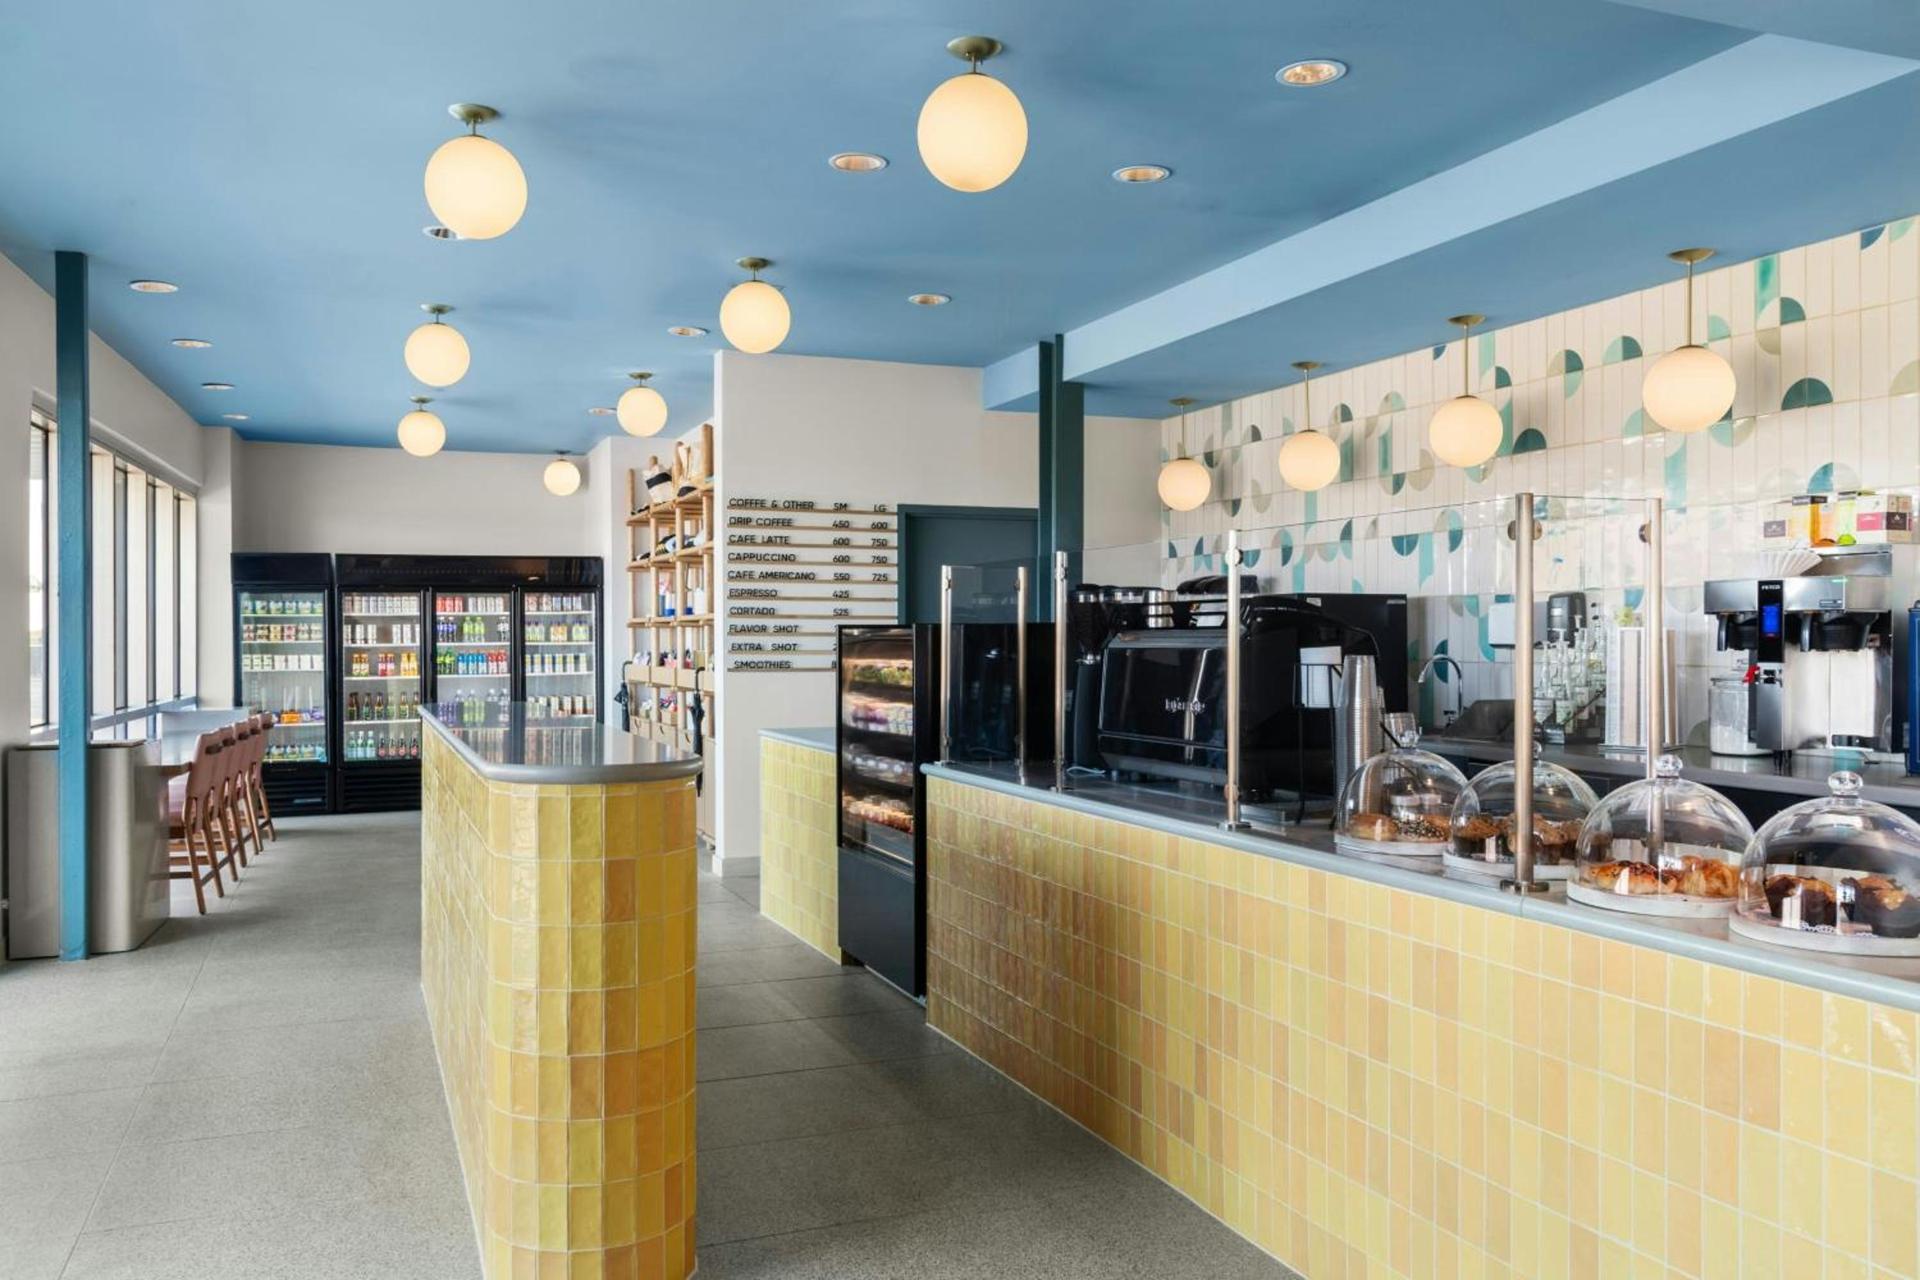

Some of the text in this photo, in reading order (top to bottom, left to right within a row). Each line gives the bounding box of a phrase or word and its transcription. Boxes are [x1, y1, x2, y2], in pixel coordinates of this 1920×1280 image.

[783, 500, 815, 510] OTHER
[833, 502, 848, 511] SM
[873, 504, 887, 513] LG
[729, 516, 888, 530] DRIP COFFEE 450 600
[729, 534, 888, 547] CAFE LATTE 600 750
[728, 552, 888, 564] CAPPUCCINO 600 750
[728, 570, 888, 582] CAFE AMERICANO 550 725
[729, 588, 849, 599] ESPRESSO 425
[729, 606, 849, 617] CORTADO 525
[728, 624, 800, 634] FLAVOR SHOT
[731, 643, 799, 652] EXTRA SHOT
[734, 660, 792, 669] SMOOTHIES
